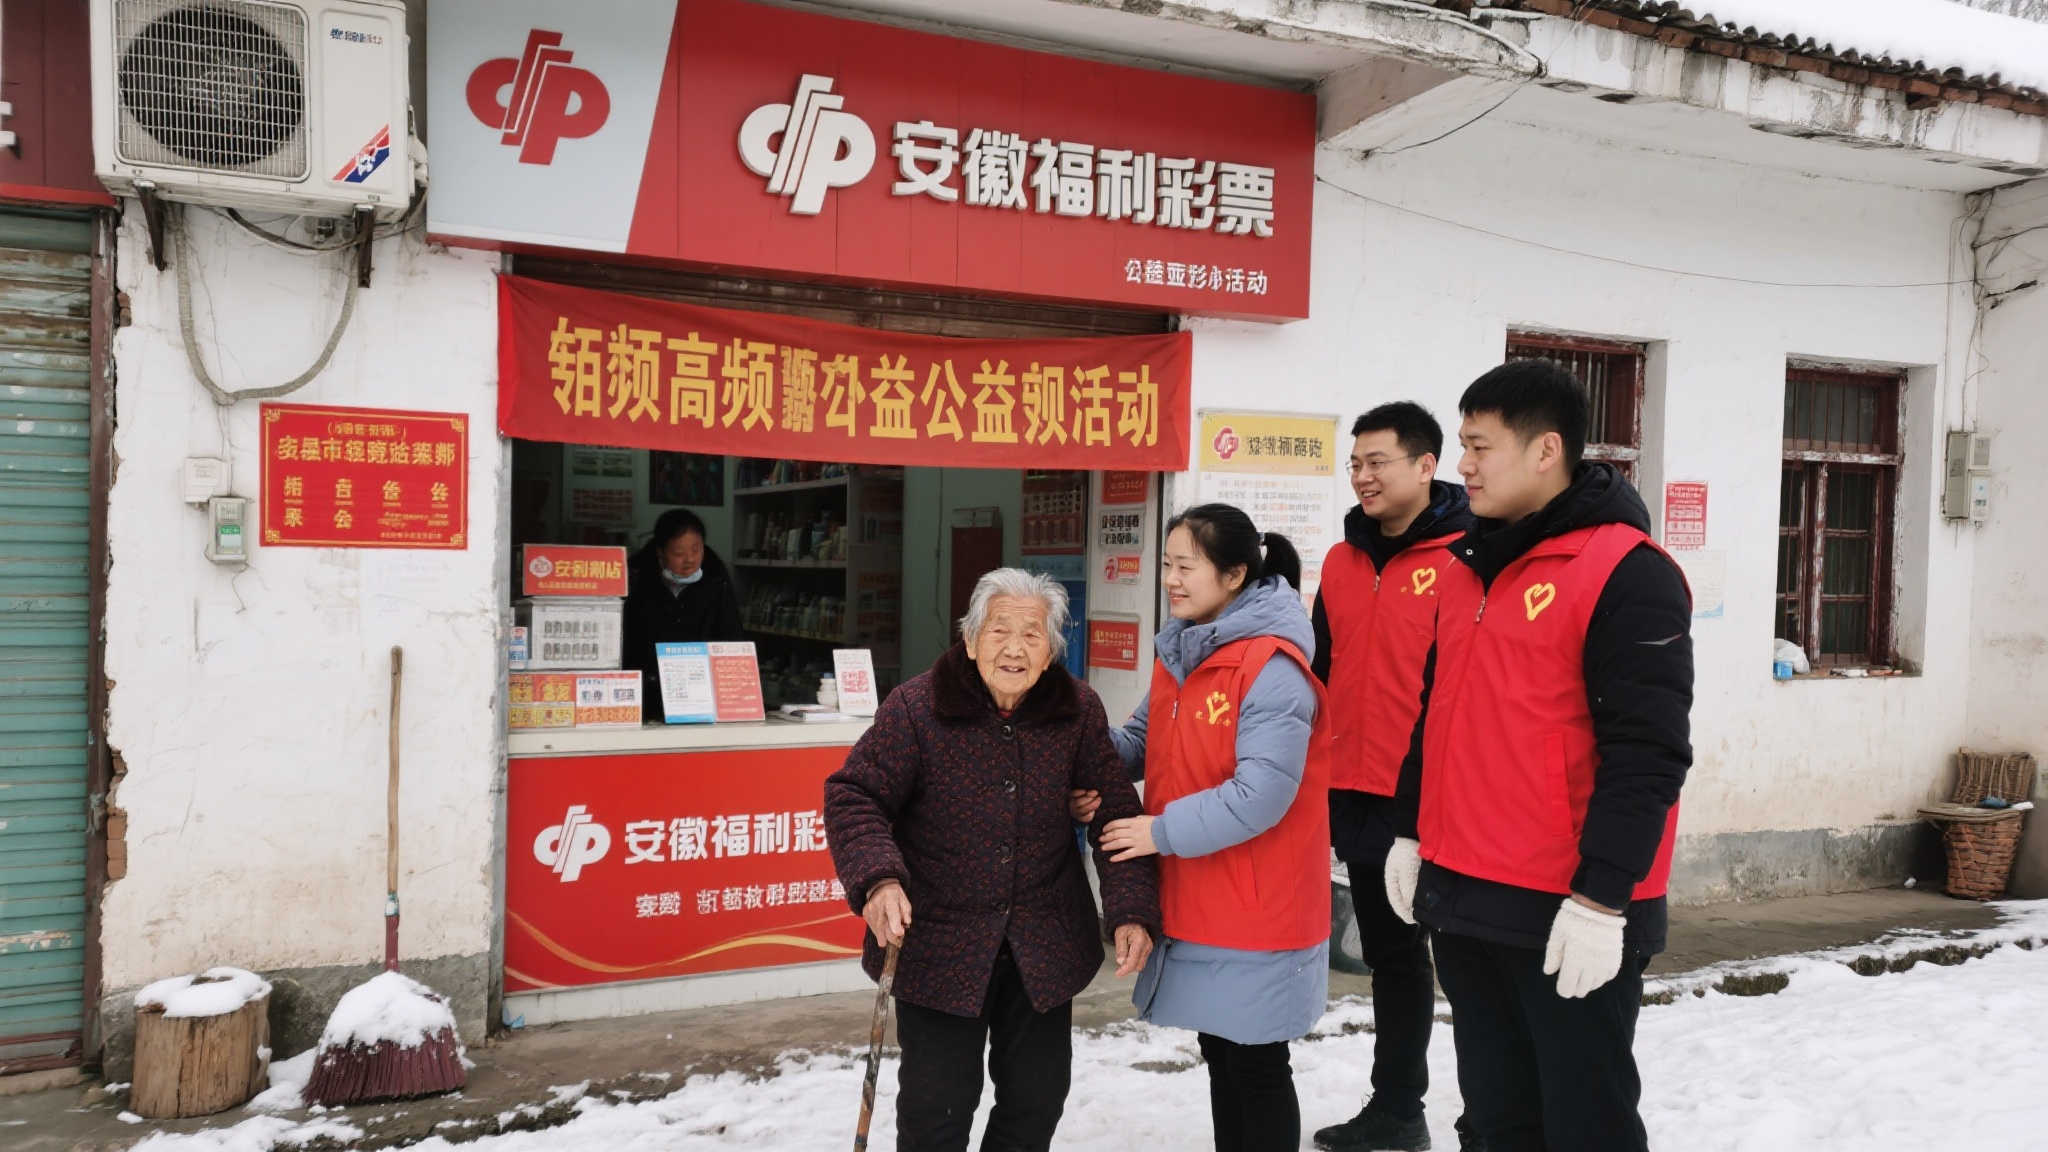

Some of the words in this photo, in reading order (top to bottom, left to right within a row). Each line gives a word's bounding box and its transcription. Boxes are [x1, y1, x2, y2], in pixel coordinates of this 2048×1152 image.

[892, 119, 1274, 238] 安徽福利彩票
